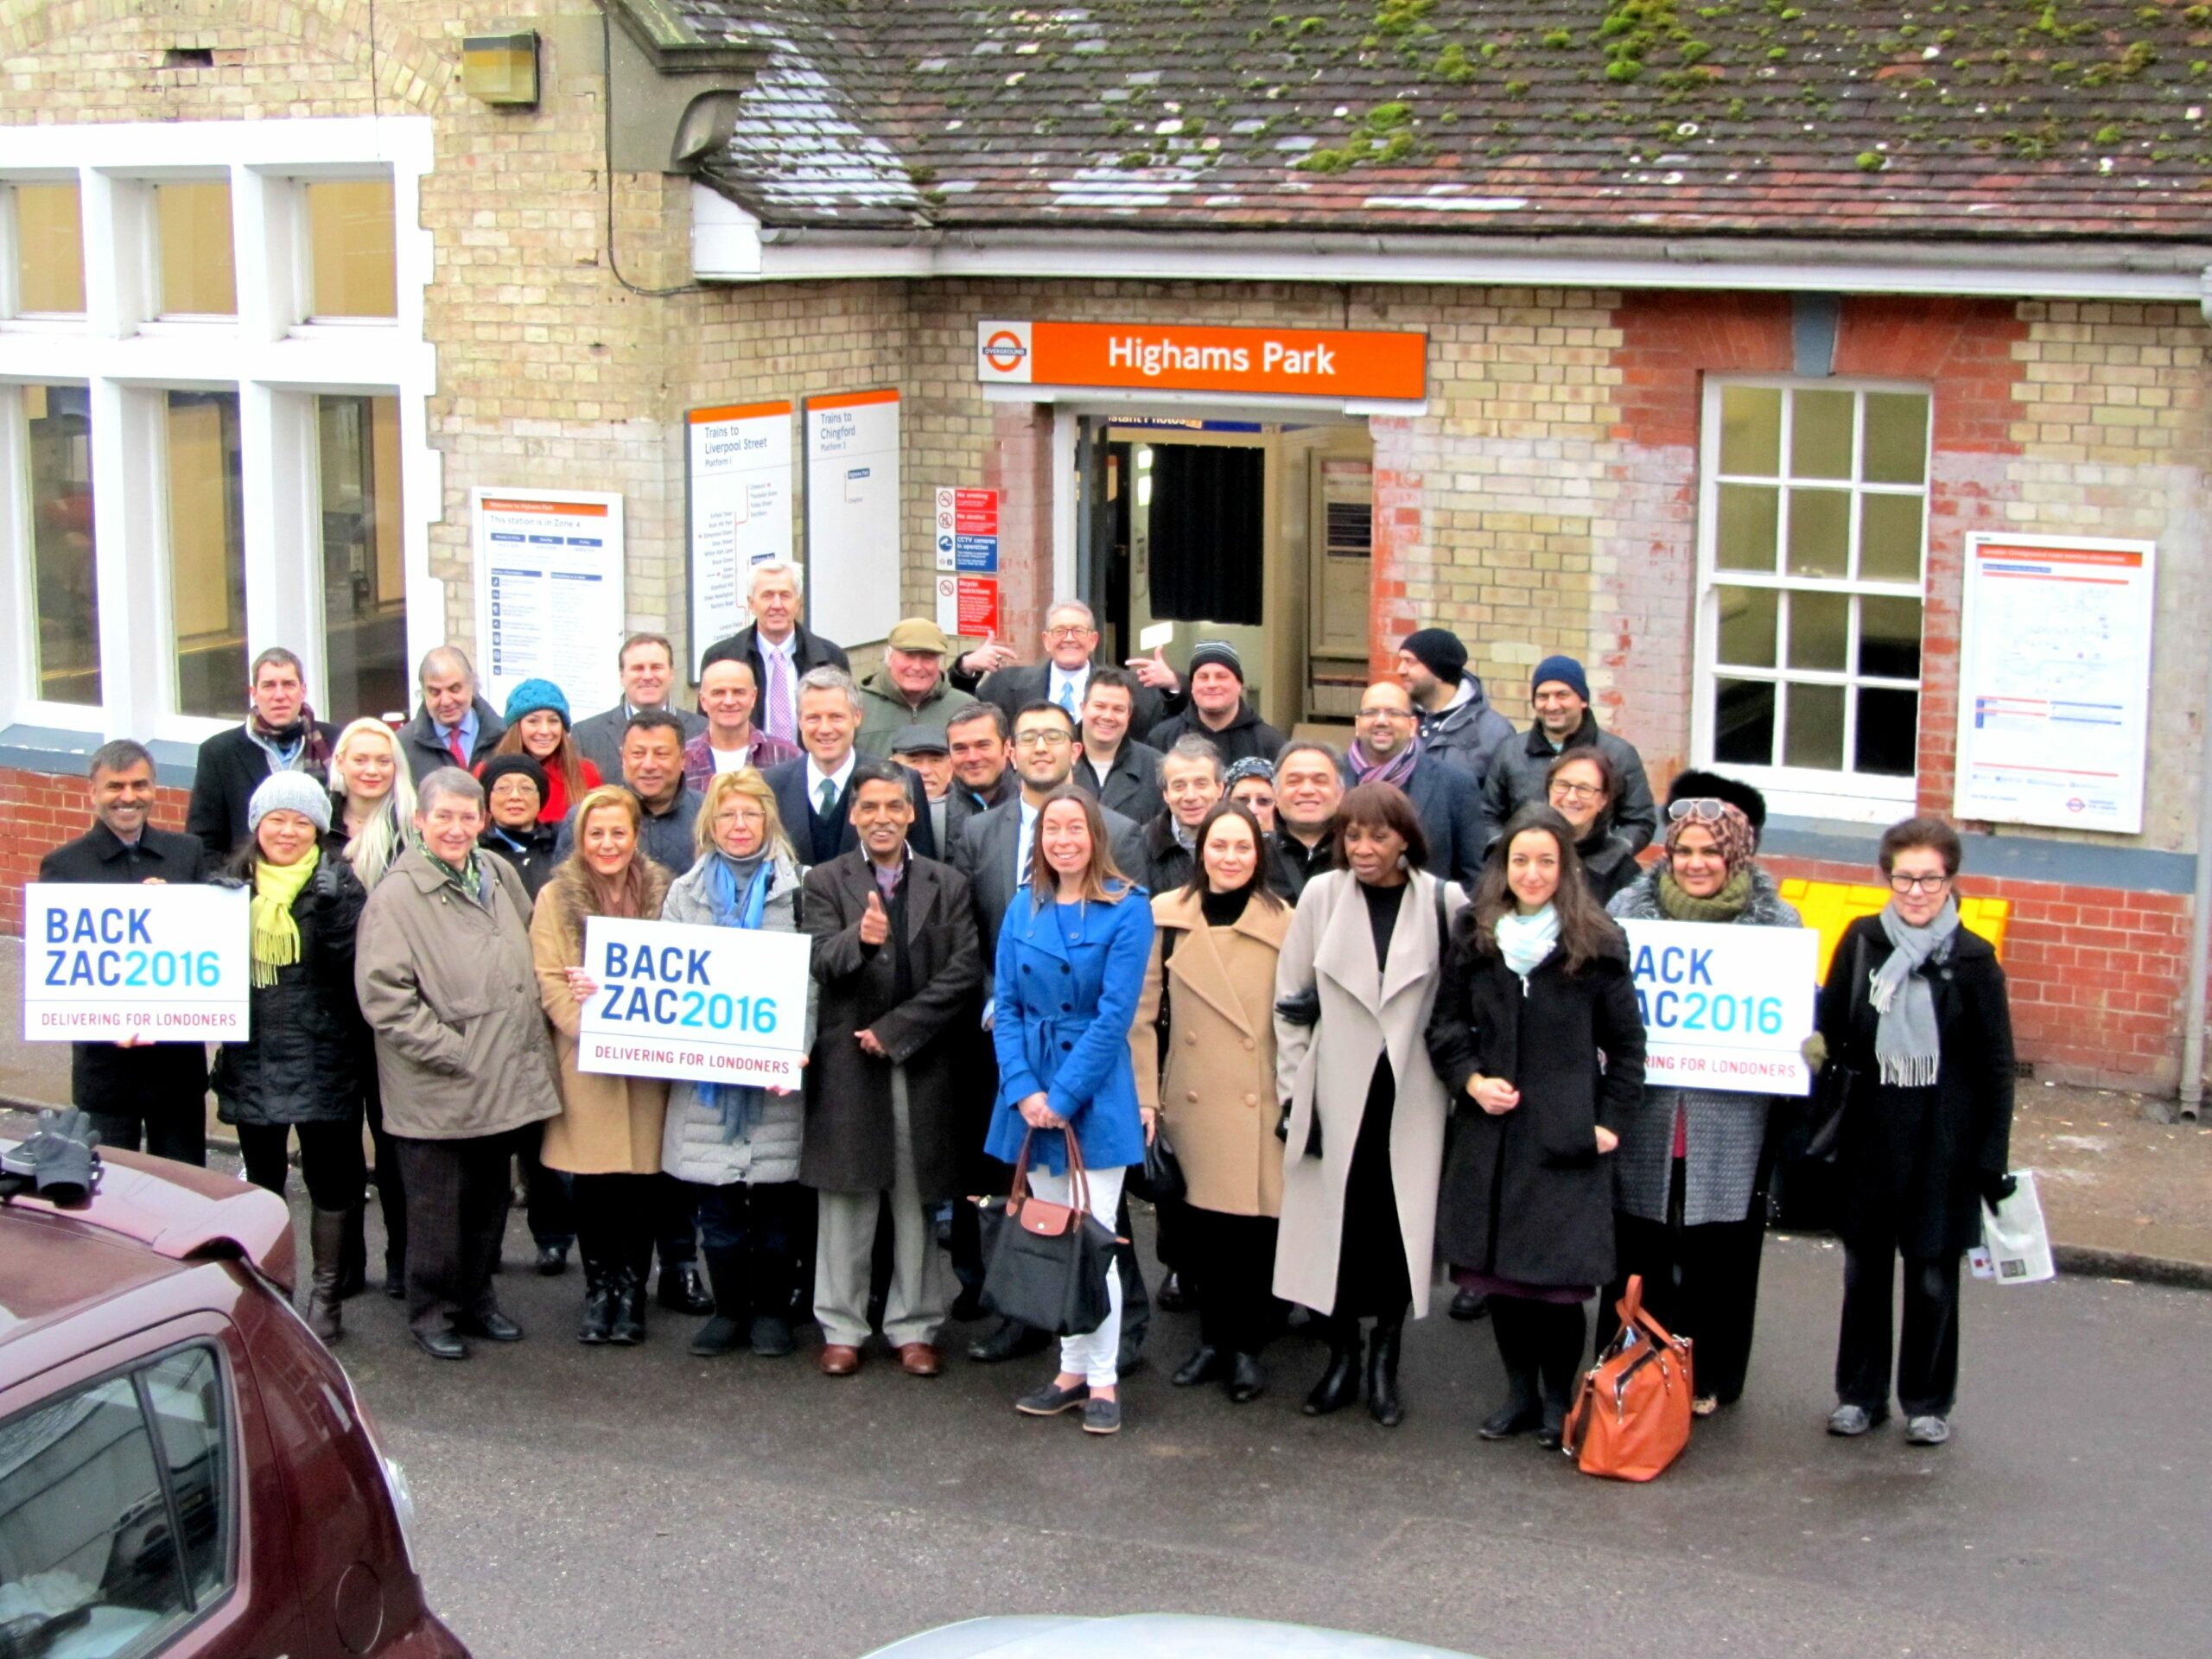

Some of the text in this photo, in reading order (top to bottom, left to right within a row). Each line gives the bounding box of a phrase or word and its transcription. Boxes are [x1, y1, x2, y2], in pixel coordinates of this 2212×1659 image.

[1108, 337, 1336, 376] Highams Park
[820, 413, 852, 424] Trains to
[704, 425, 740, 438] Trains to
[820, 425, 855, 440] Chingford
[705, 437, 768, 454] Liverpool Street
[704, 457, 728, 467] Platform
[508, 517, 535, 525] station
[554, 519, 574, 528] Zone
[46, 907, 153, 944] BACK
[44, 950, 221, 988] ZAC2016
[604, 942, 713, 986] BACK
[1632, 944, 1714, 986] ACK
[41, 1013, 237, 1027] DELIVERING FOR LONDONERS
[601, 983, 777, 1034] ZAC2016
[1635, 988, 1783, 1035] AC2016
[594, 1045, 790, 1075] DELIVERING FOR LONDONERS
[1680, 1057, 1706, 1071] FOR
[1711, 1060, 1796, 1077] LONDONERS
